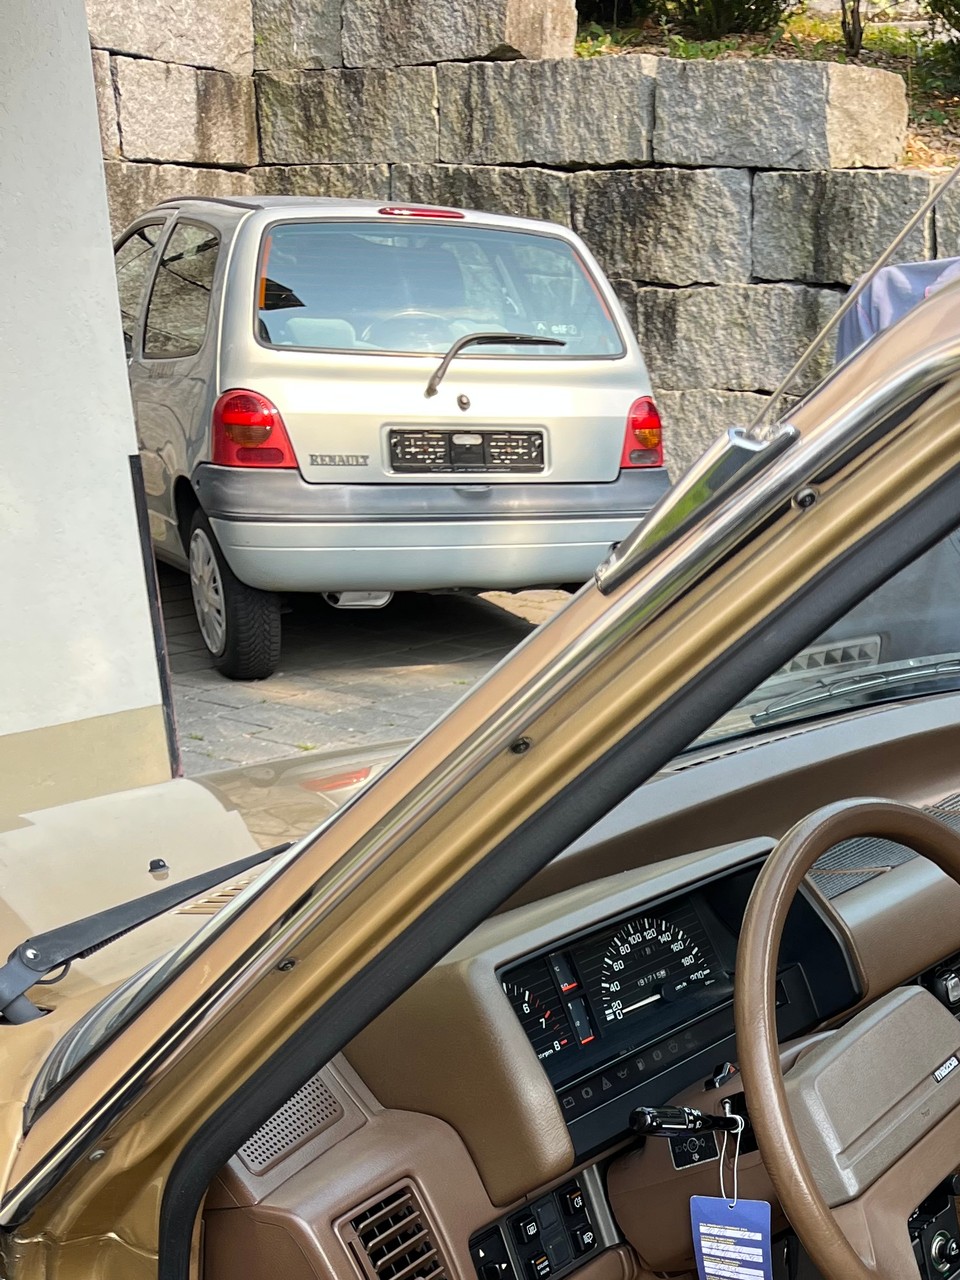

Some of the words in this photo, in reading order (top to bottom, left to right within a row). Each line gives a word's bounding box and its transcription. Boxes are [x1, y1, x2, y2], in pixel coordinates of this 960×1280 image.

[309, 454, 369, 466] RENAULT
[628, 932, 642, 945] 100
[643, 928, 657, 940] 120
[657, 932, 672, 944] 140
[619, 944, 631, 955] 80
[670, 940, 684, 953] 160
[612, 960, 624, 971] 60
[681, 954, 695, 966] 180
[609, 981, 621, 992] 40
[522, 1003, 530, 1014] 6
[611, 1000, 623, 1011] 20
[615, 1009, 623, 1020] 0
[539, 1018, 546, 1029] 7
[553, 1040, 561, 1051] 8
[933, 1056, 960, 1081] mazda
